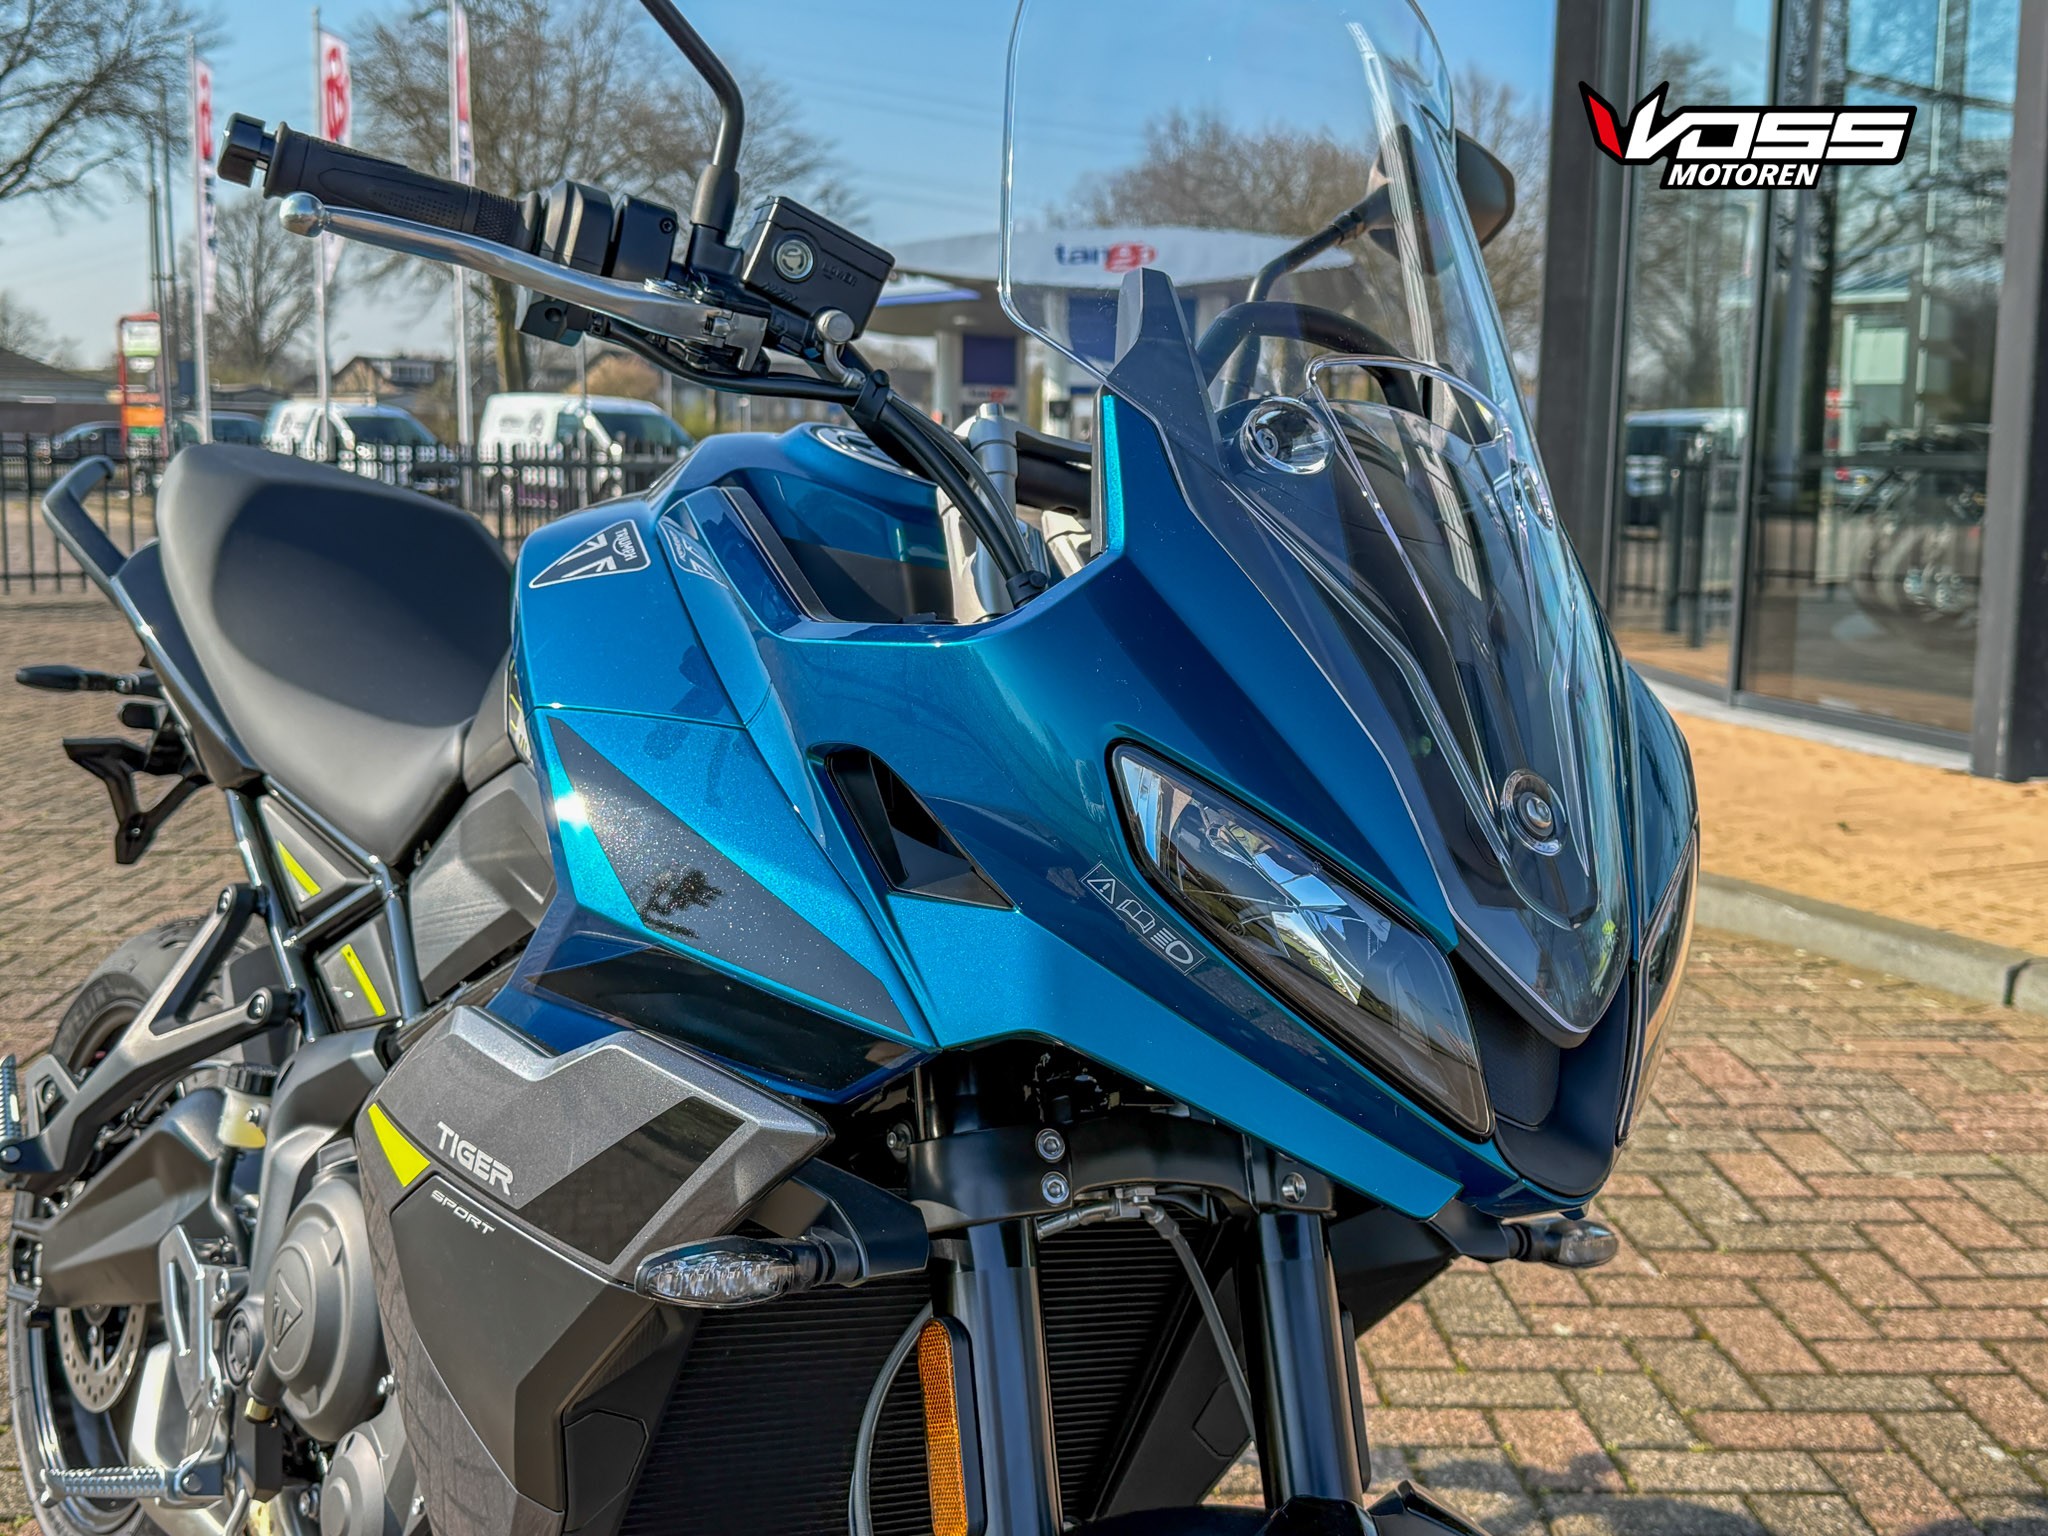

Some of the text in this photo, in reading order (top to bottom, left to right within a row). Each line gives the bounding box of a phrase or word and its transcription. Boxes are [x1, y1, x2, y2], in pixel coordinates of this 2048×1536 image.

[614, 527, 638, 562] TRIUMPH
[437, 1121, 514, 1196] TIGER
[430, 1190, 496, 1234] SPORT
